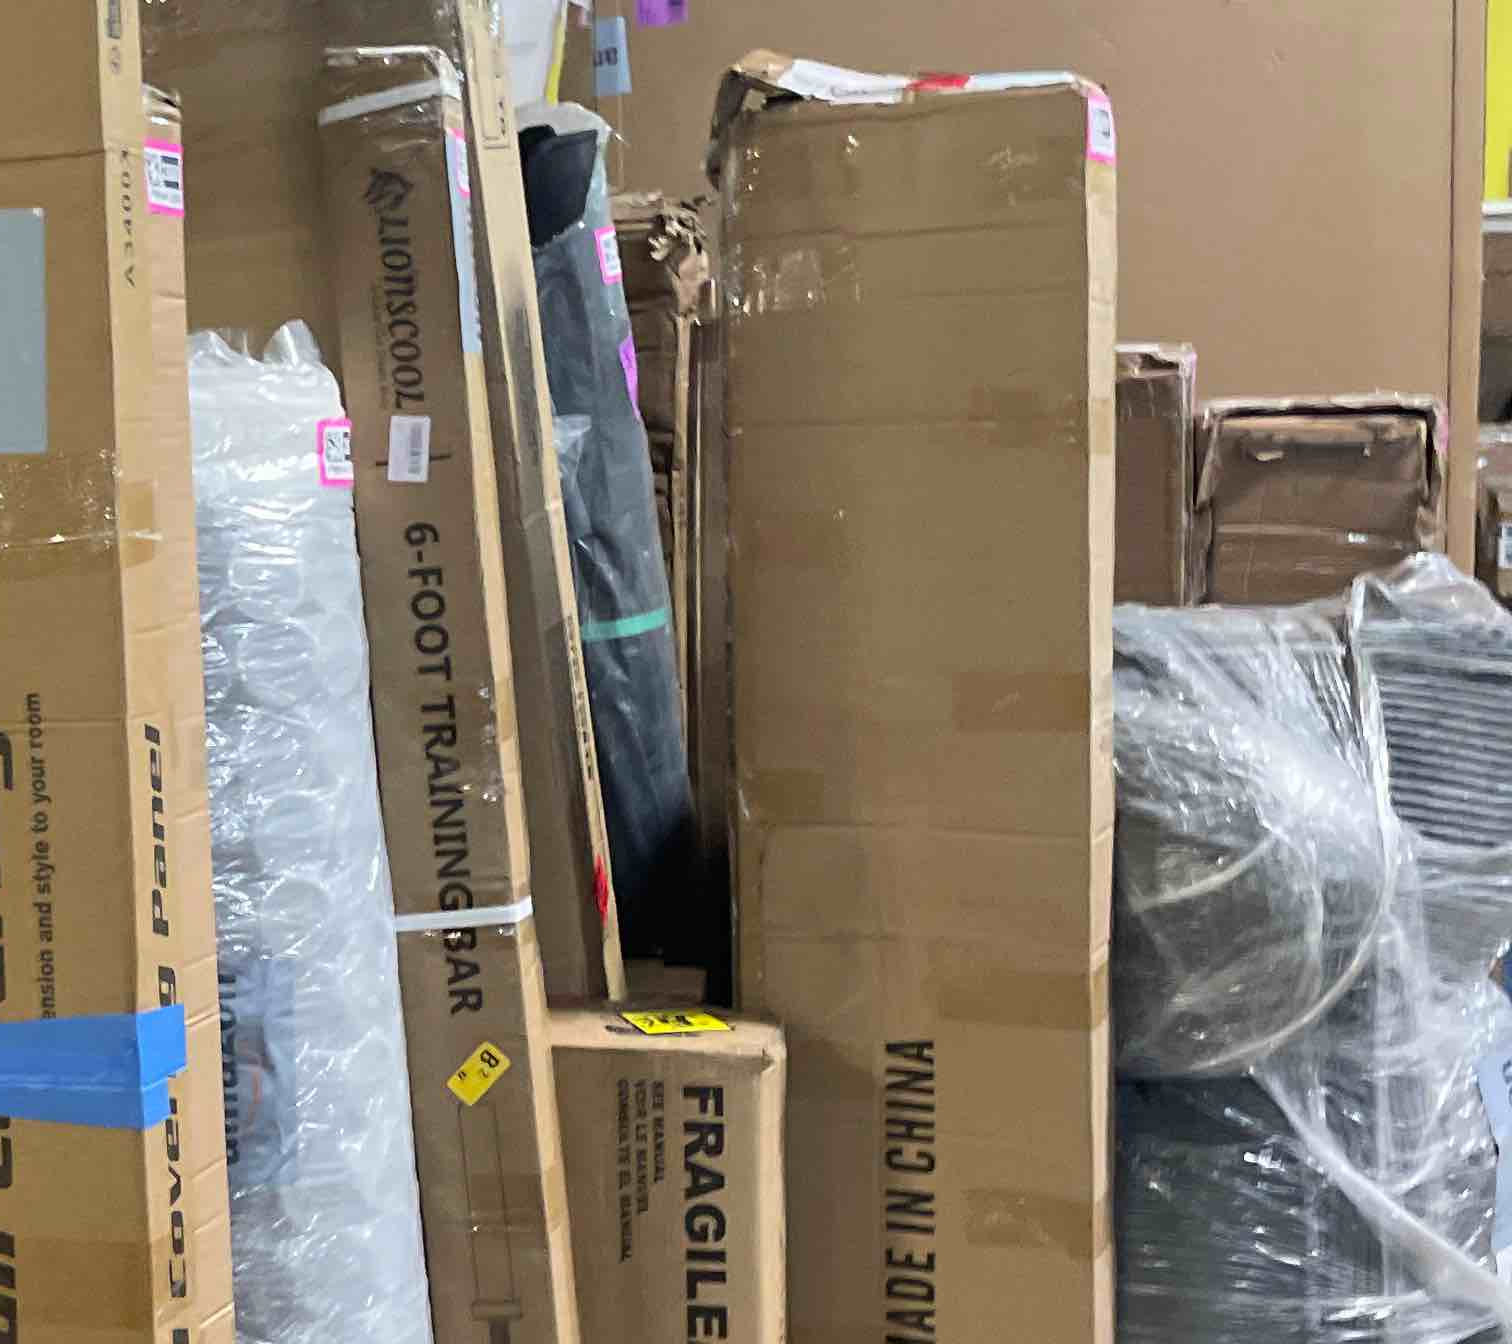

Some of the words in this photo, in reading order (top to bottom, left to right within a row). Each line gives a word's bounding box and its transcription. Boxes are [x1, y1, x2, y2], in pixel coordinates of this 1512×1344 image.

[403, 520, 453, 681] 6-FOOT
[26, 692, 44, 750] room
[29, 757, 53, 805] your
[420, 695, 474, 913] TRAINING
[30, 811, 50, 835] to
[144, 722, 170, 937] Panel
[32, 842, 56, 896] style
[32, 902, 55, 943] and
[443, 925, 483, 1016] BAR
[884, 1039, 937, 1174] CHINA
[885, 1189, 936, 1236] IN
